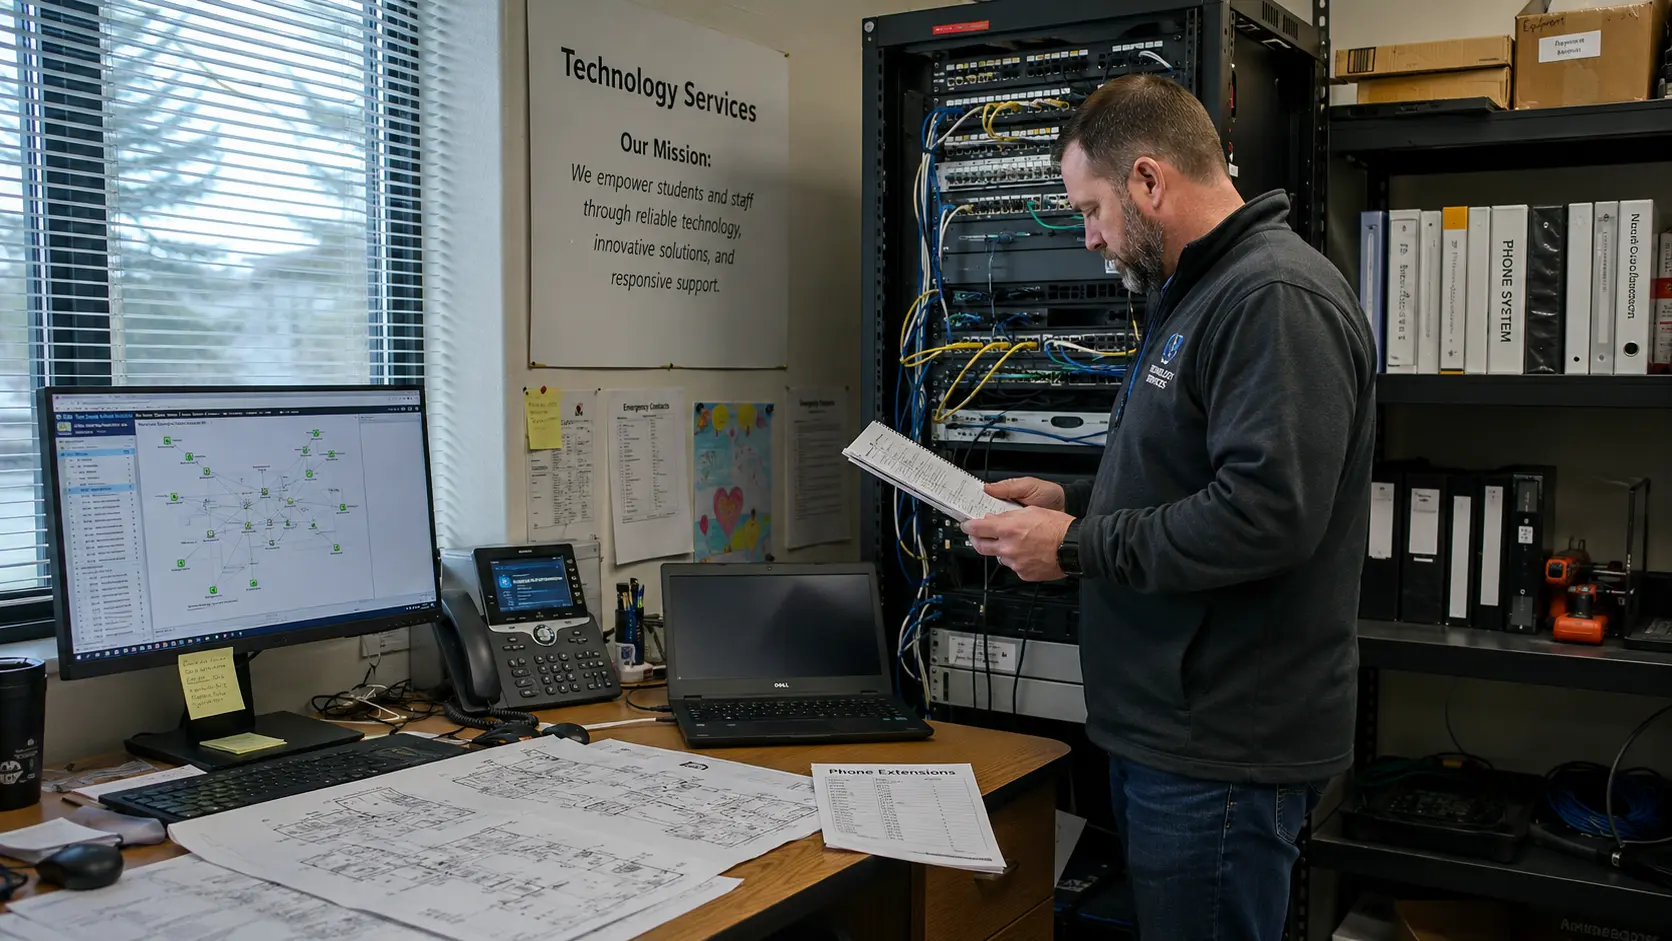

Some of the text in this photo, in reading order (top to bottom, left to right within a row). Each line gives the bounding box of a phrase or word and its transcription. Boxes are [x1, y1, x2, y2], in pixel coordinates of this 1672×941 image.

[561, 46, 757, 122] Technology Services
[620, 132, 712, 167] Our Mission:
[571, 163, 754, 211] We empower students and staff
[583, 199, 742, 239] through reliable technology,
[593, 233, 735, 265] innovative solutions, and
[1502, 239, 1514, 287] PHONE
[611, 271, 720, 296] responsive support.
[623, 402, 670, 413] Emergency Contacts
